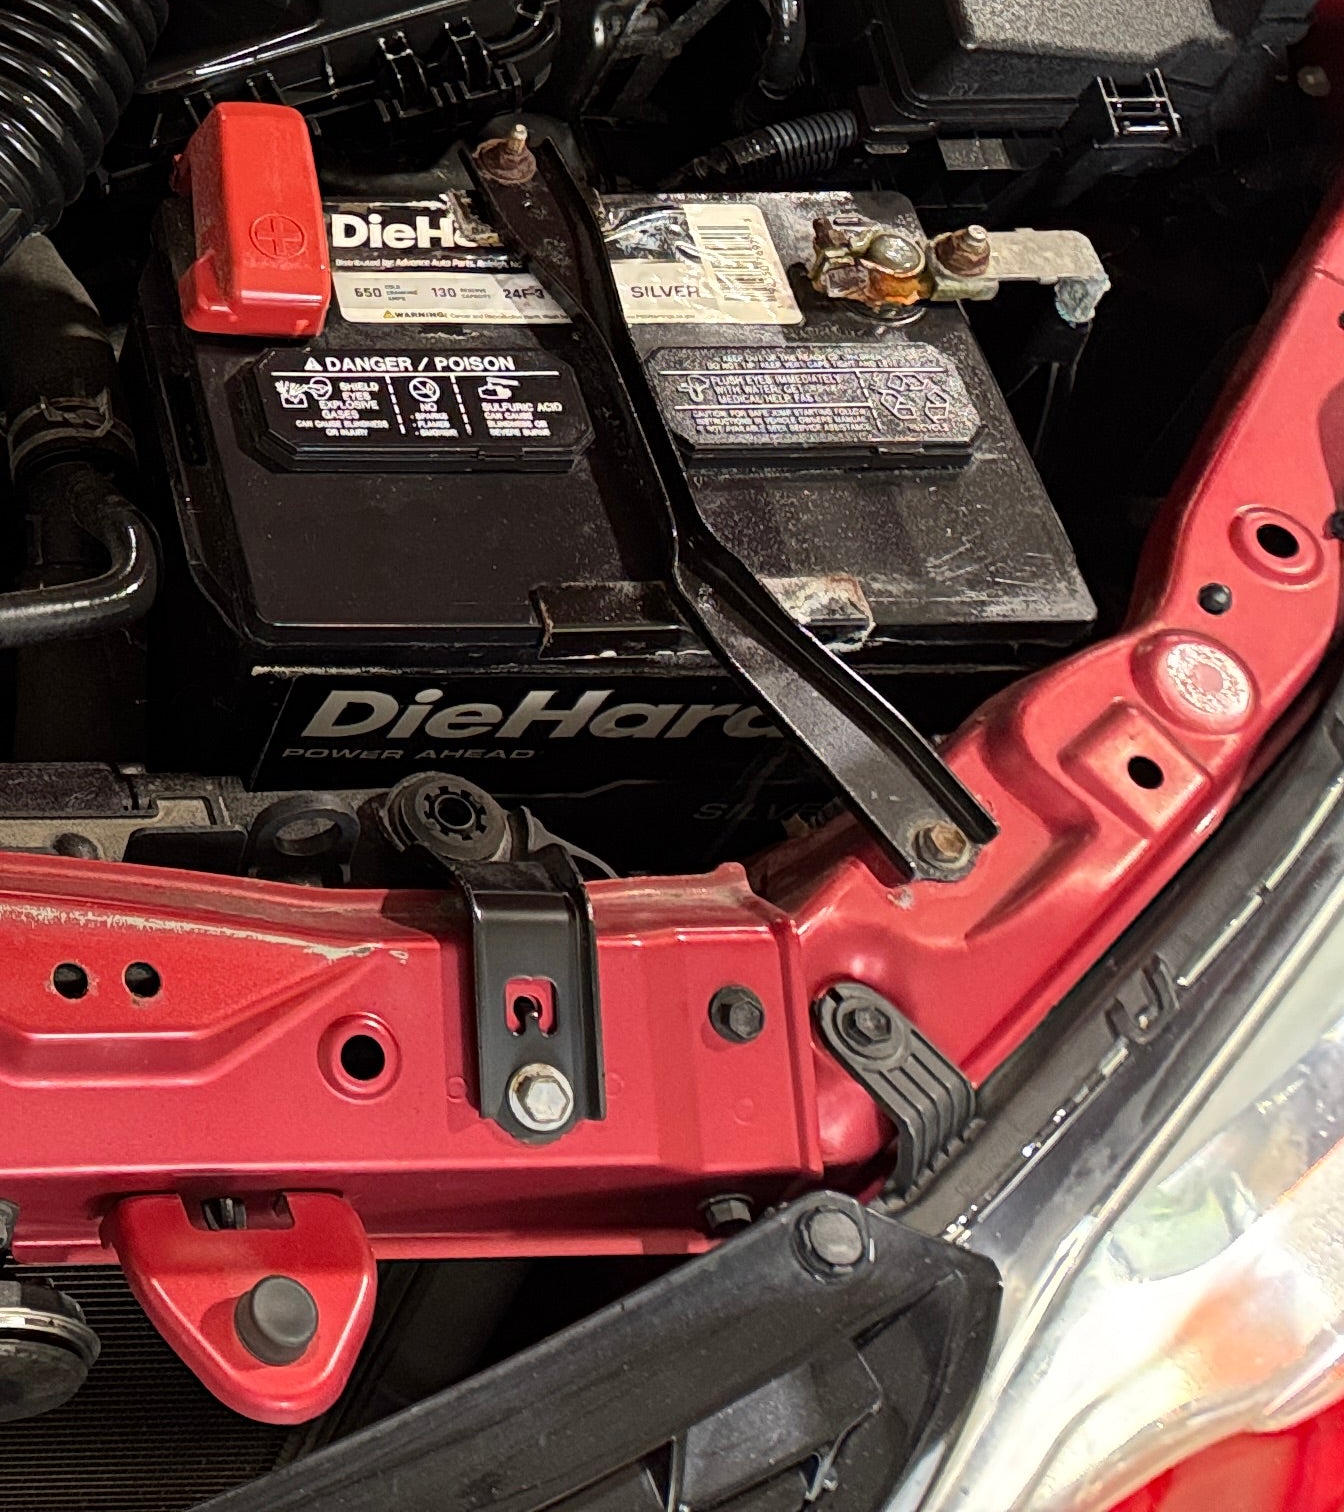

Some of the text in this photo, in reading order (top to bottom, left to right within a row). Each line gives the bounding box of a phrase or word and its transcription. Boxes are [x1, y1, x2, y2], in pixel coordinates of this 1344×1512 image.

[354, 287, 383, 298] 650
[431, 287, 457, 298] 130
[324, 355, 517, 372] DANGER / POISON
[711, 374, 842, 386] FLUSH EYES IMMEDIATELY
[338, 381, 380, 392] SHIELD
[714, 385, 743, 395] WITH
[341, 391, 372, 401] EYES
[317, 400, 380, 410] EXPLOSIVE
[419, 402, 438, 412] NO
[480, 402, 563, 412] SULFURIC ACID
[321, 409, 360, 419] GASES
[281, 748, 536, 759] POWER AHEAD
